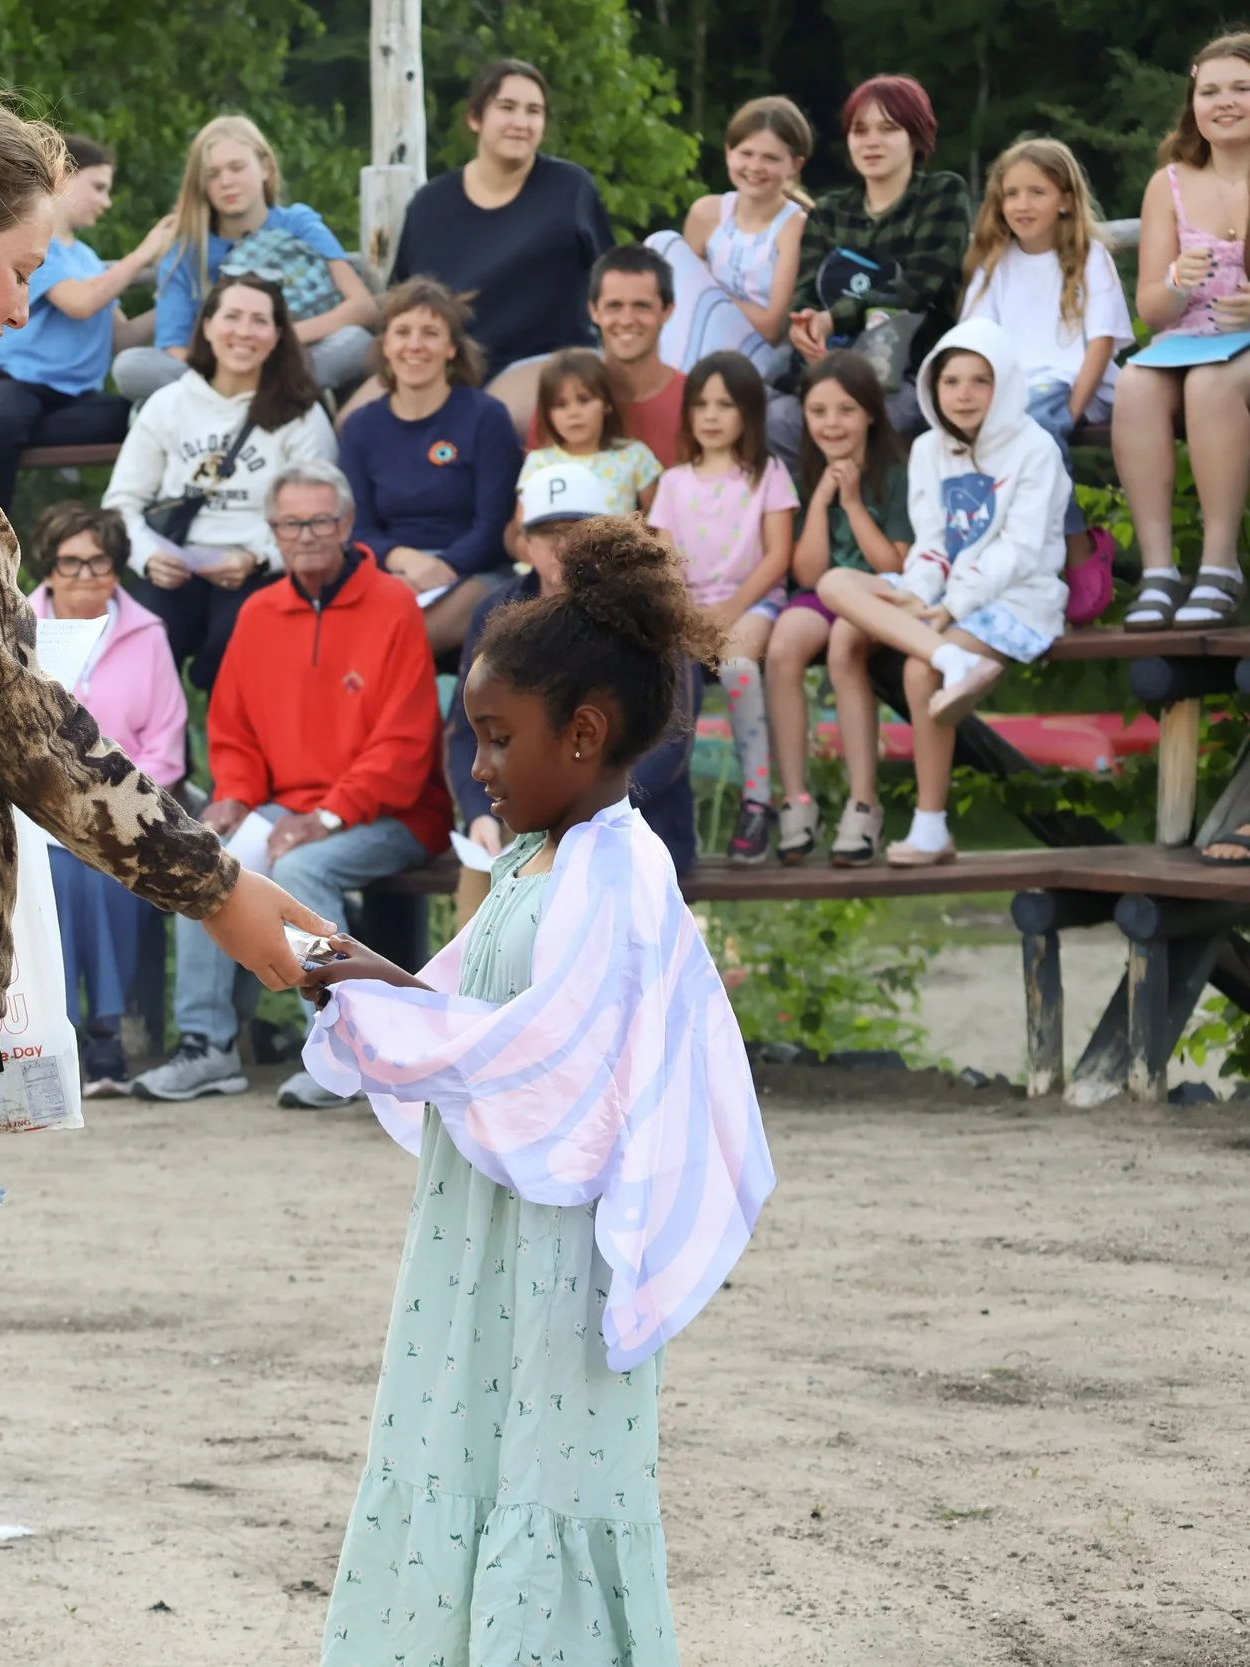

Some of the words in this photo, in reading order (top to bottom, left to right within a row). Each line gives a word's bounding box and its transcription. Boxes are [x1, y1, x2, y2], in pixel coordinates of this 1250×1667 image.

[178, 433, 266, 472] OLORDO
[549, 477, 567, 504] P
[13, 1045, 43, 1060] Day
